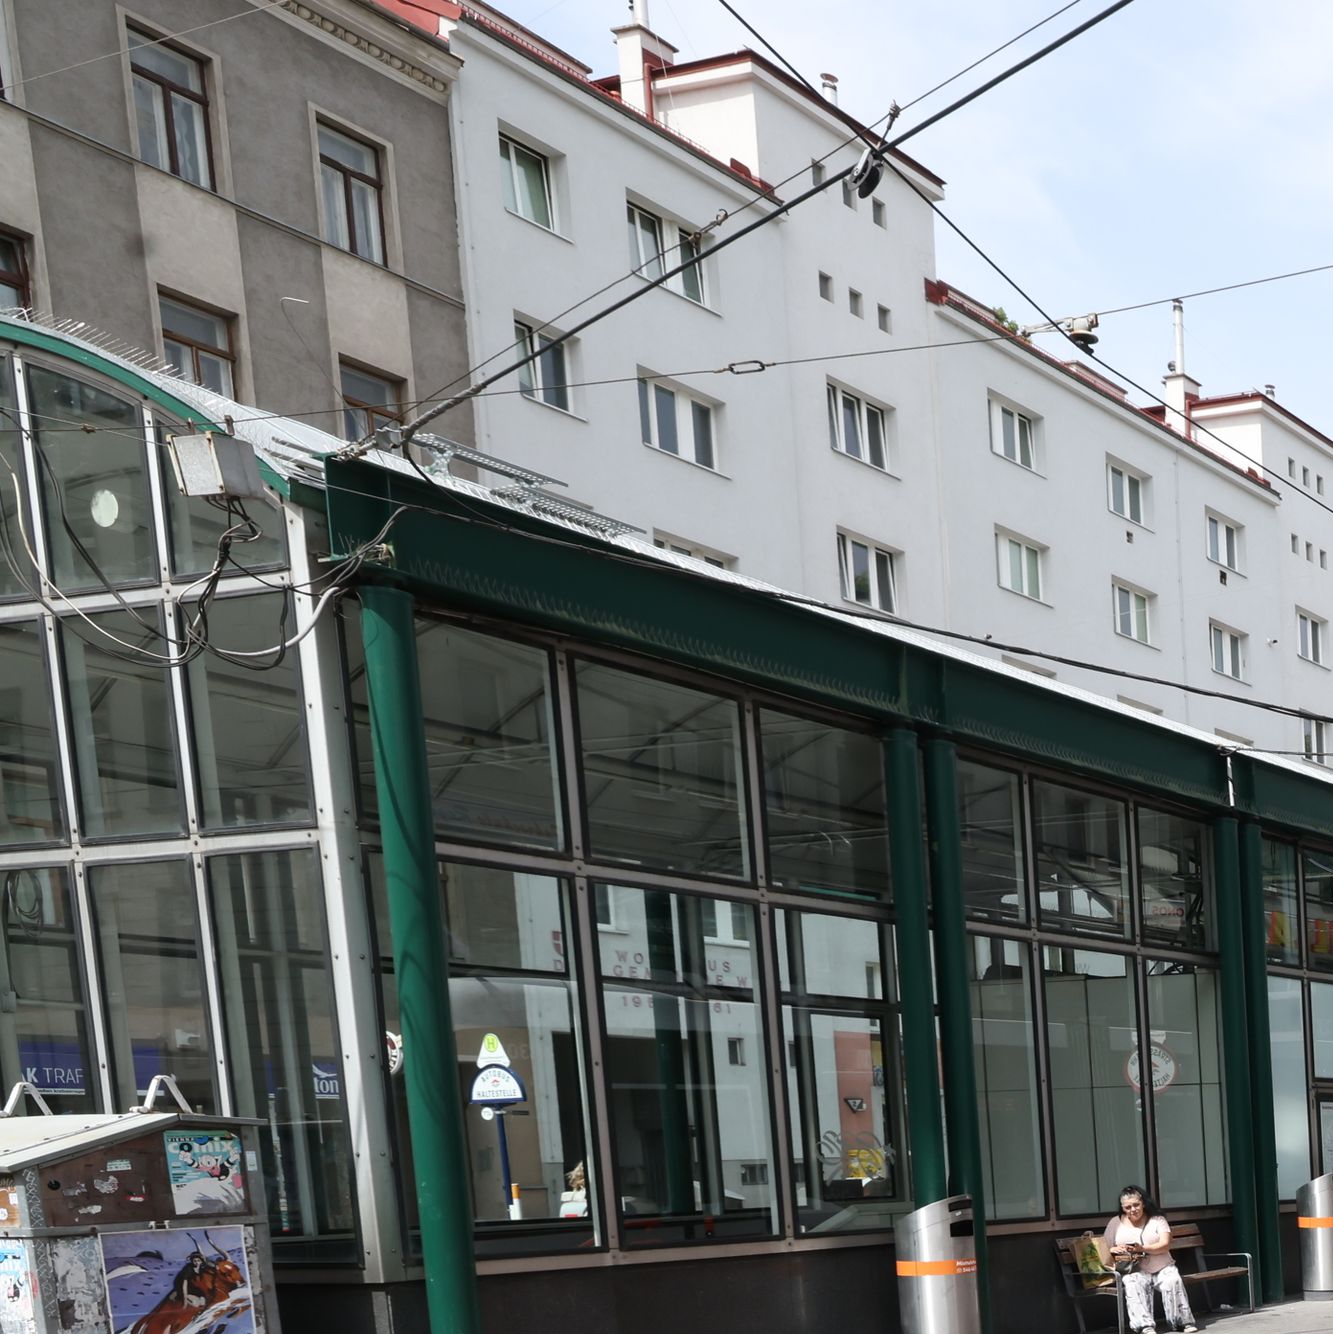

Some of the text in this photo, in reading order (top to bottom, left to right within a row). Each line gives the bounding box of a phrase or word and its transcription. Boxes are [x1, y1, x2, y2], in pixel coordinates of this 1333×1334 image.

[486, 1038, 496, 1049] H
[481, 1070, 510, 1083] AUTOBUS
[477, 1089, 517, 1098] HALTESTELLE
